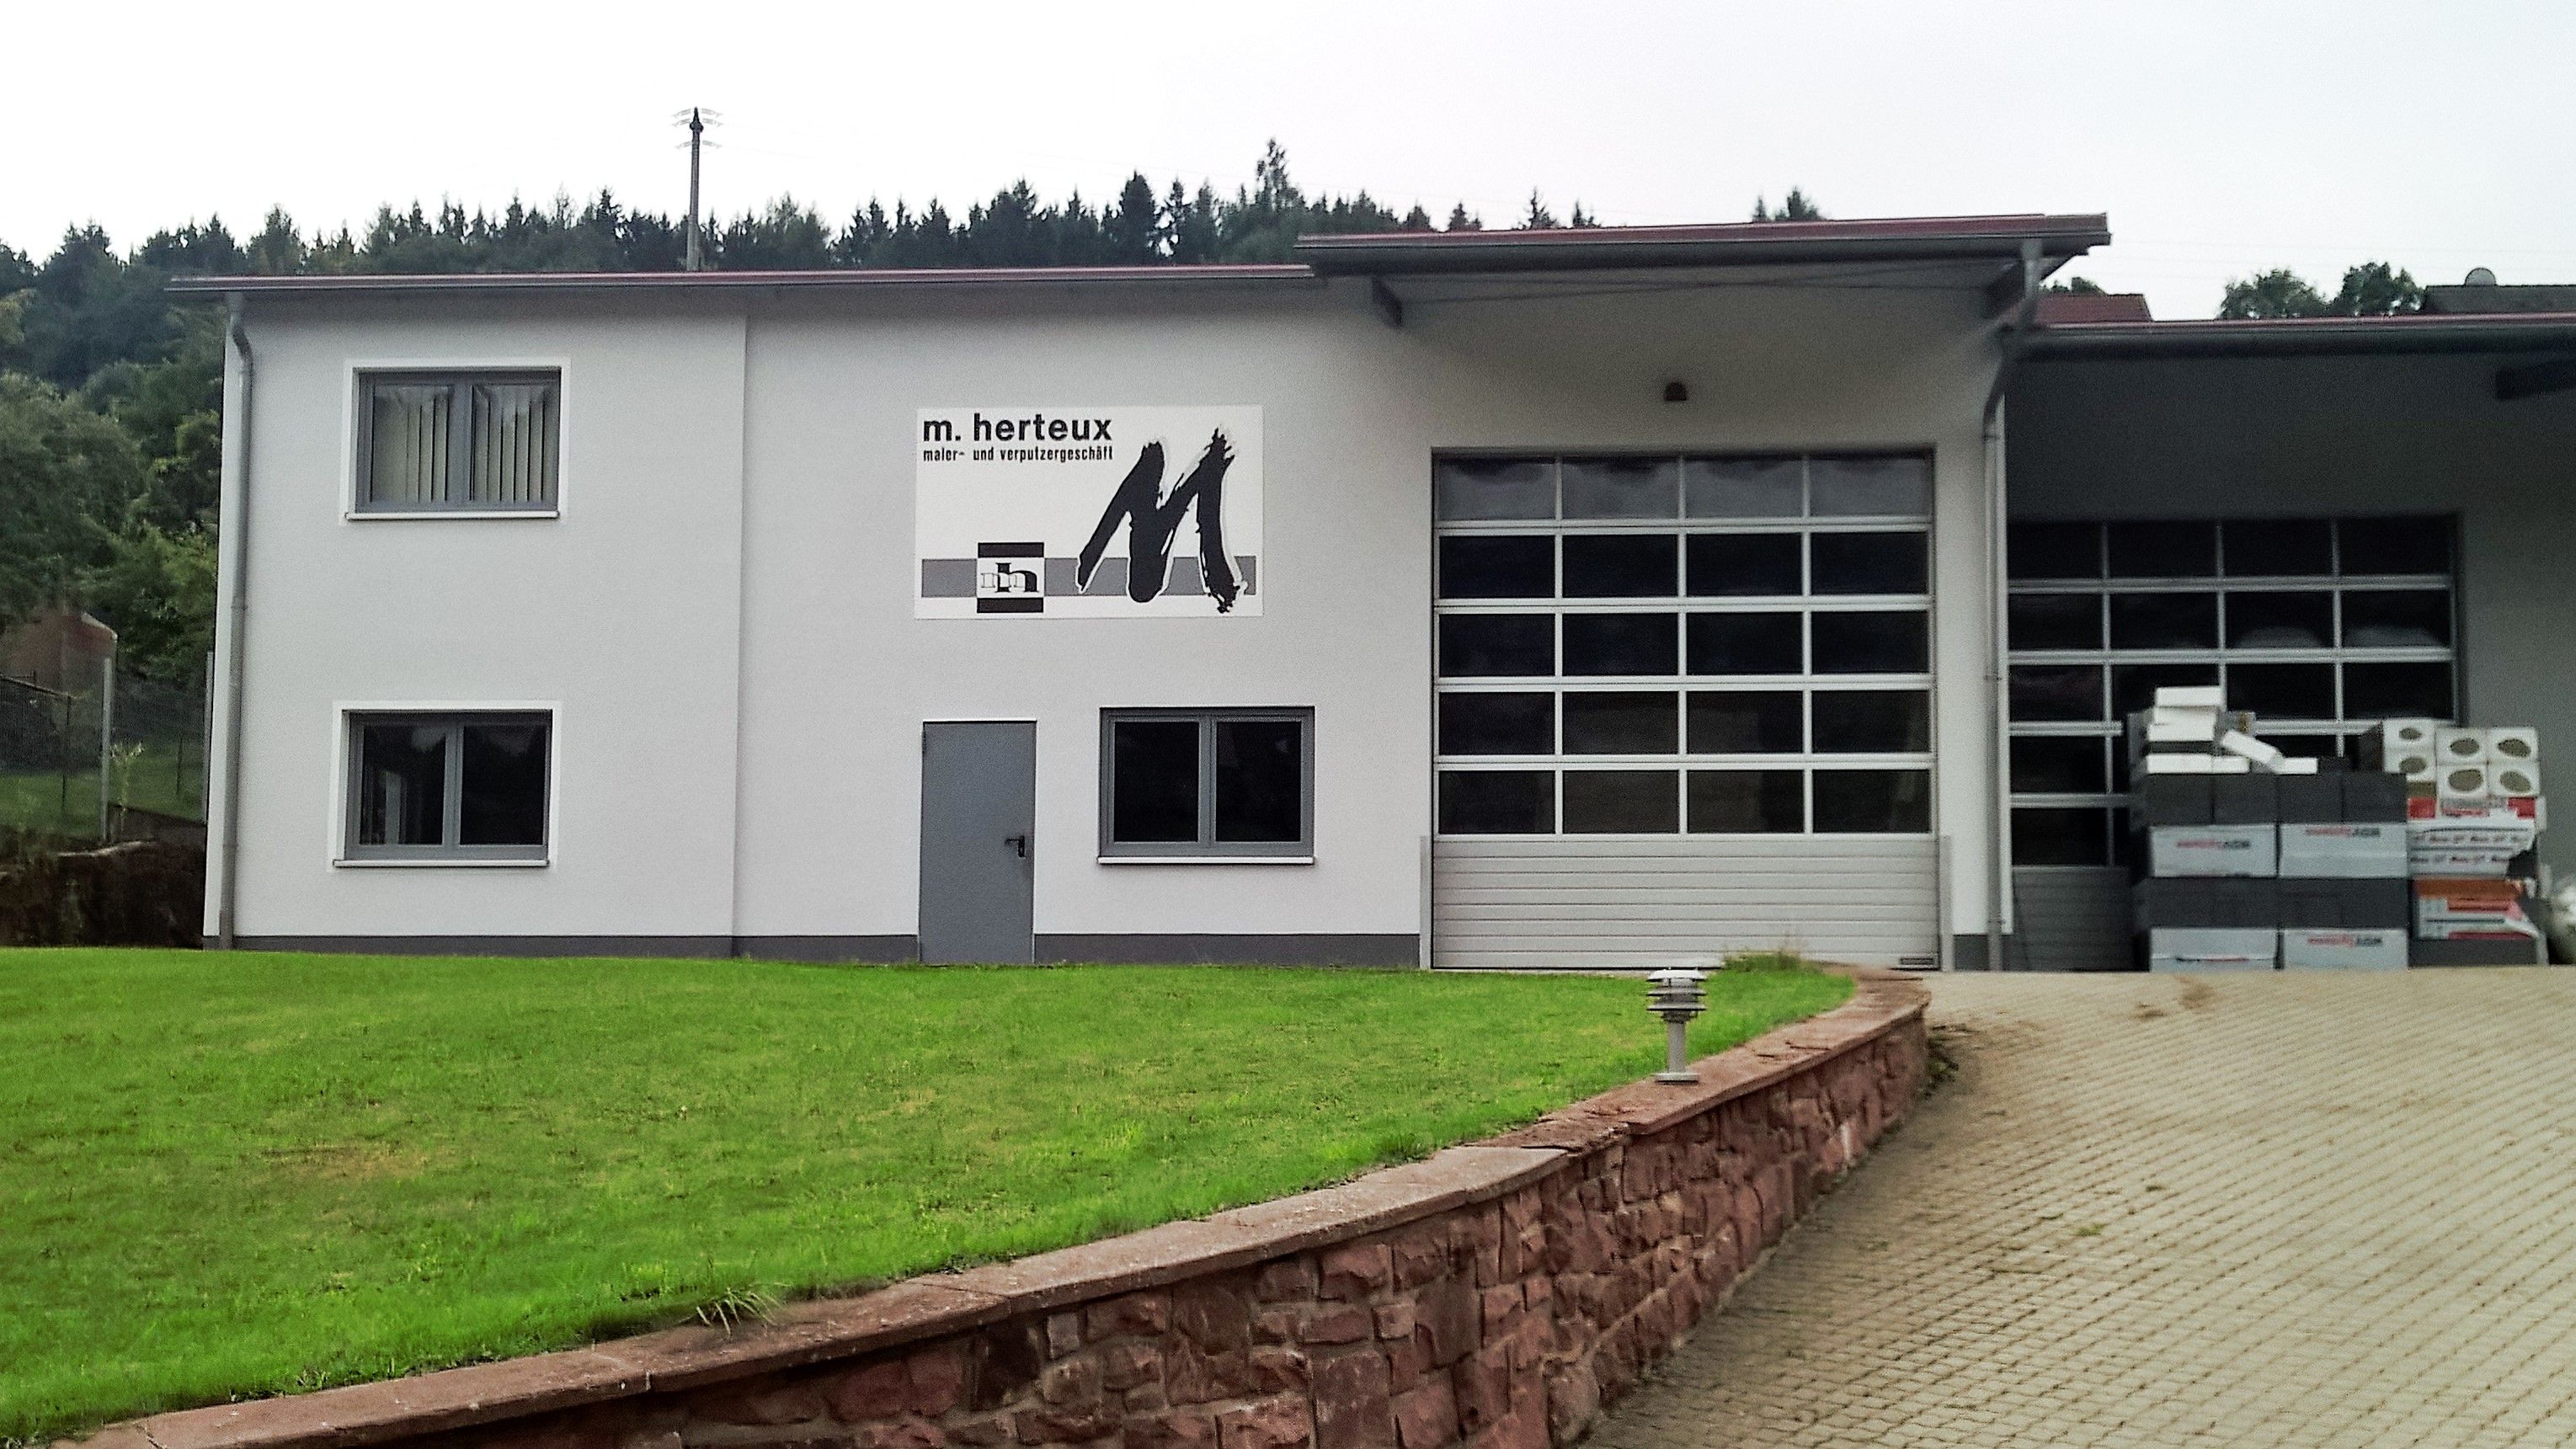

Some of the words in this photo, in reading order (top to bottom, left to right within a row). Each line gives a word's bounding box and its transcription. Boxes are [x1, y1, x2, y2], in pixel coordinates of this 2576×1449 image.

[923, 419, 962, 442] m.
[973, 412, 1112, 442] herteux
[923, 446, 965, 462] maler-
[973, 445, 995, 461] und
[1000, 445, 1113, 464] verputzergeschäft
